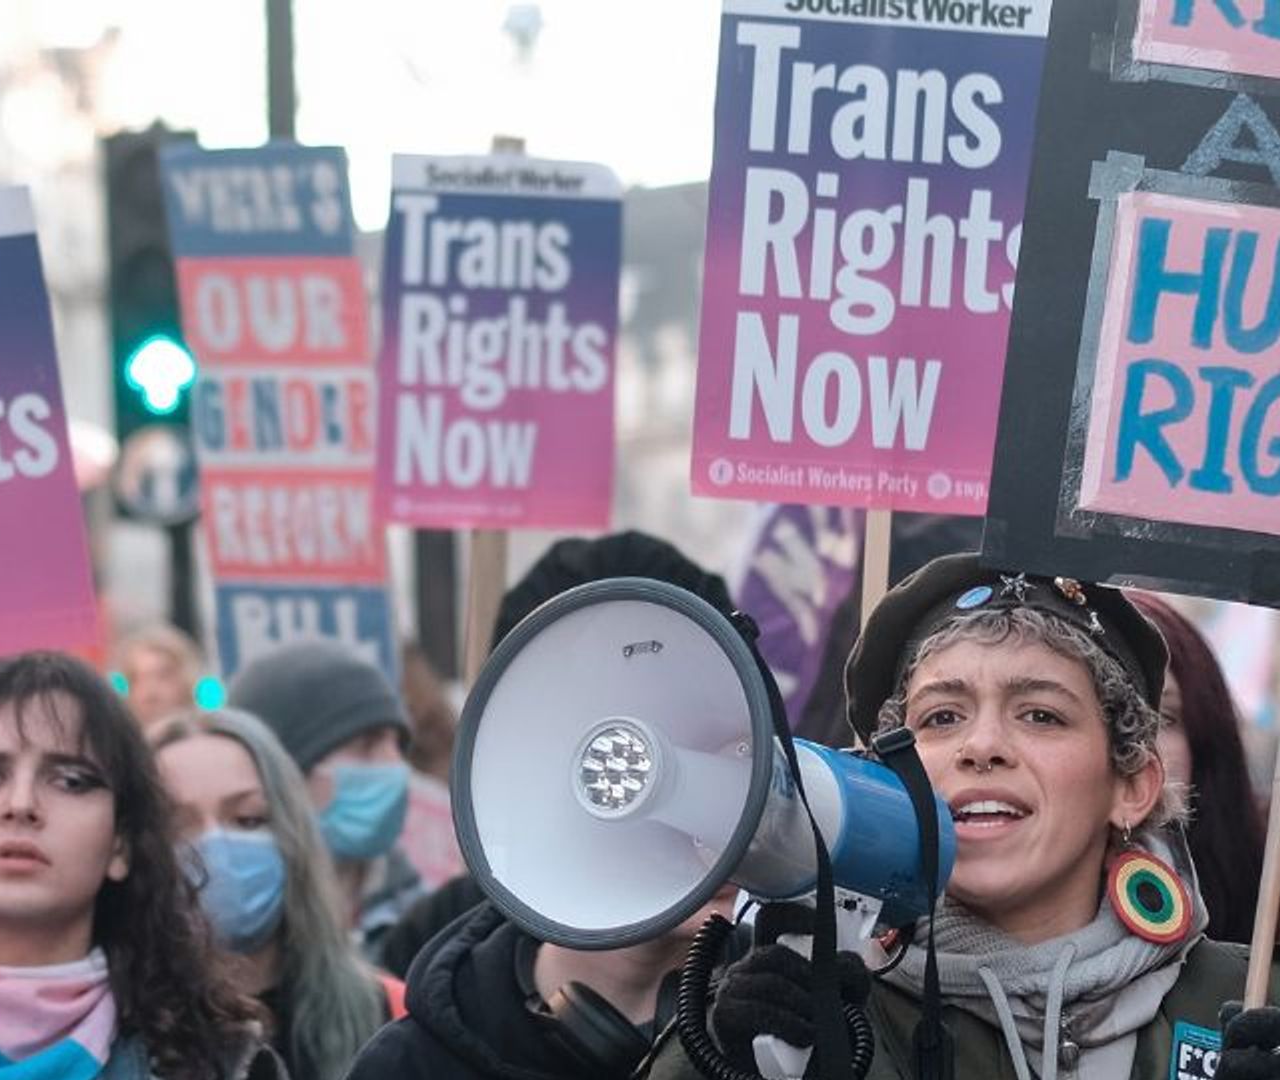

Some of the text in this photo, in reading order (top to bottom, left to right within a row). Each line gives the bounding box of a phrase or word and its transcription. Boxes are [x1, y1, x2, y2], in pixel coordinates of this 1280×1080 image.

[736, 22, 1003, 169] Trans
[395, 195, 570, 290] Trans
[194, 272, 345, 353] OUR
[399, 292, 609, 409] Rights
[201, 379, 371, 451] GENDER
[728, 311, 942, 451] Now
[394, 394, 537, 489] Now
[736, 463, 803, 487] Socialist
[808, 466, 872, 491] Workers
[878, 473, 917, 496] Party
[212, 483, 372, 566] REFORM
